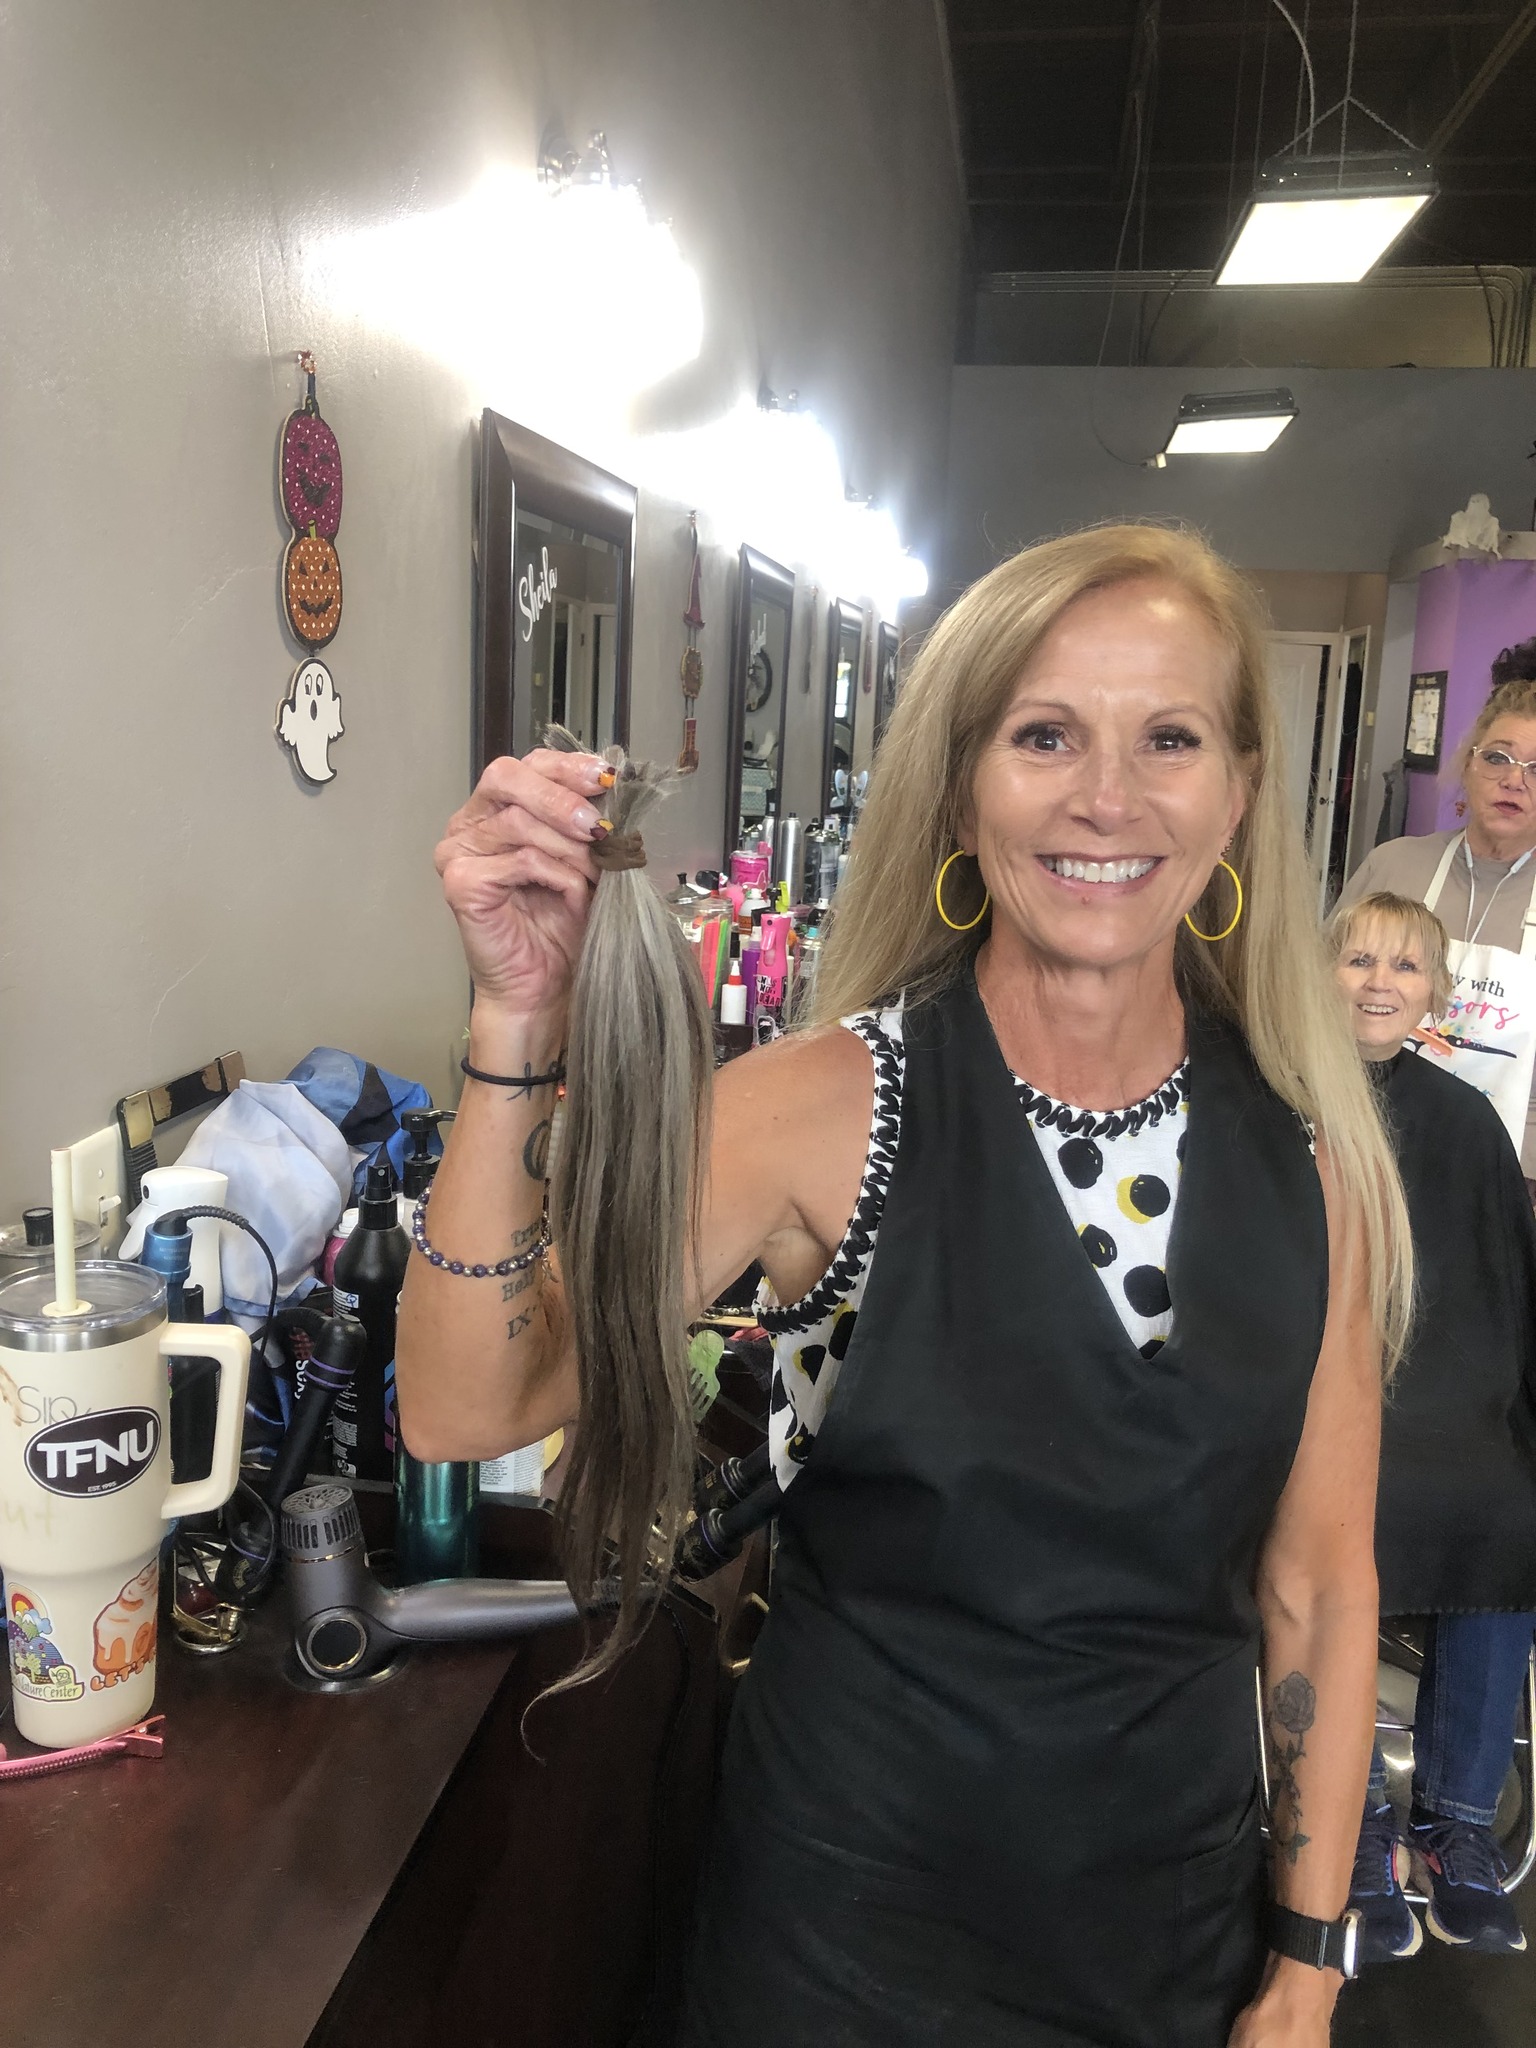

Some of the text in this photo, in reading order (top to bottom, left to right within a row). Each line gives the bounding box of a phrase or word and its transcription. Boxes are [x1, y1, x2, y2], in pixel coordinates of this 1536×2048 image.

[519, 546, 558, 642] Sheila
[1470, 976, 1506, 998] with
[36, 1420, 154, 1479] TFNU
[43, 1685, 79, 1699] Center
